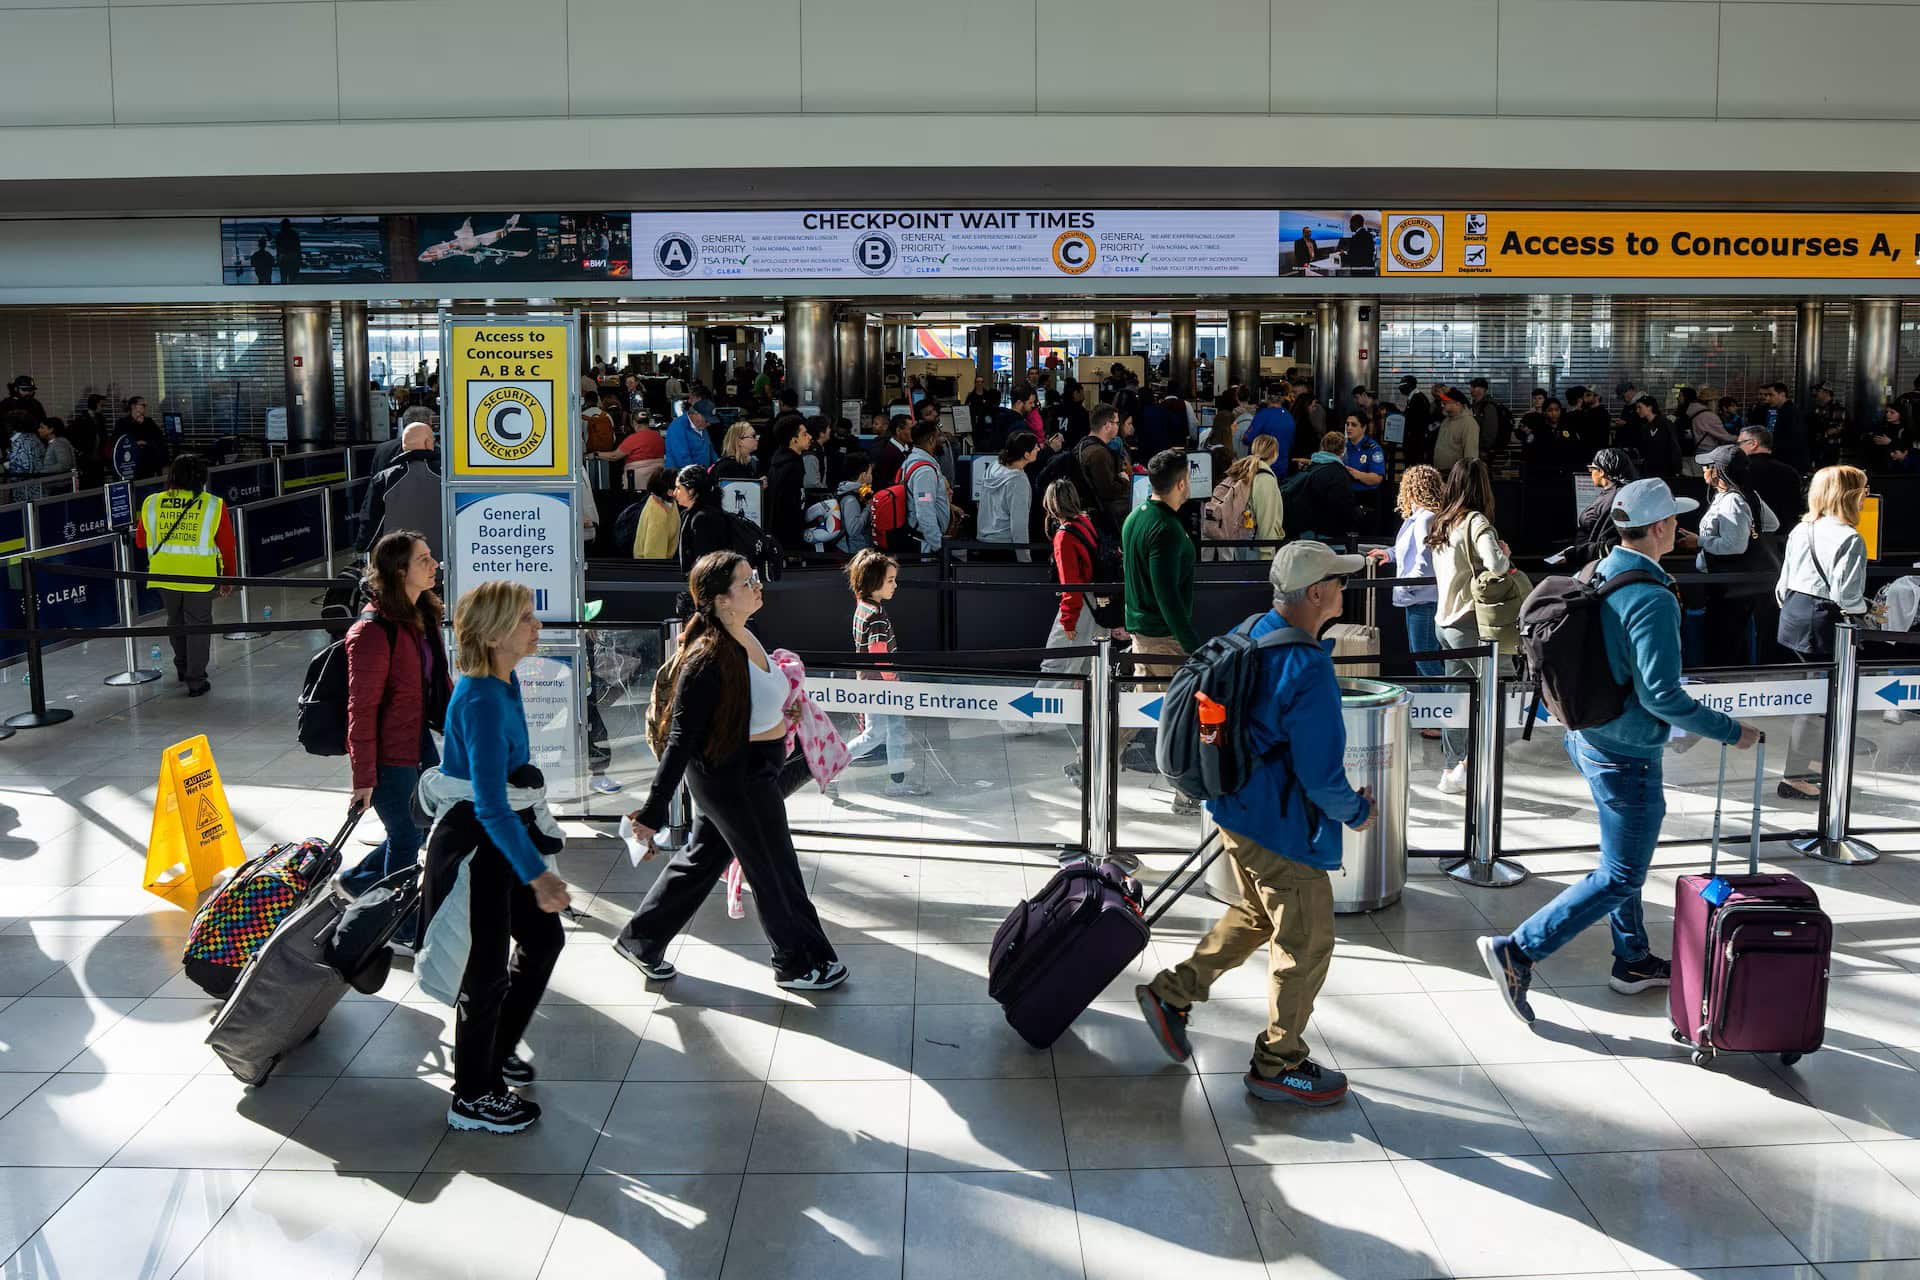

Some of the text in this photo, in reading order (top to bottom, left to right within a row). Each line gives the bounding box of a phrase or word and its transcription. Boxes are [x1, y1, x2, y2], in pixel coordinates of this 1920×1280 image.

[803, 212, 1095, 230] CHECKPOINT WAIT TIMES
[901, 234, 945, 242] GENERAL
[1100, 233, 1144, 241] GENERAL
[1403, 229, 1425, 256] C
[664, 240, 688, 266] A
[702, 245, 746, 253] PRIORITY
[865, 240, 886, 264] B
[901, 244, 945, 252] PRIORITY
[1062, 241, 1083, 264] C
[1100, 243, 1144, 252] PRIORITY
[1500, 231, 1614, 256] Access
[1626, 232, 1659, 256] to
[1671, 232, 1858, 256] Concourses
[1869, 233, 1901, 262] A,
[474, 331, 545, 342] Access to
[467, 348, 553, 360] Concourses
[480, 365, 540, 378] A, B & C
[483, 390, 537, 409] SECURITY
[494, 407, 522, 440] C
[480, 432, 542, 458] CHECKPOINT
[241, 486, 260, 496] CLEAR
[160, 512, 200, 520] AIRPORT
[483, 507, 540, 521] General
[80, 520, 104, 532] CLEAR
[160, 522, 199, 531] LANDSIDE
[479, 524, 546, 540] Boarding
[471, 543, 554, 556] Passengers
[472, 560, 552, 572] enter here.
[47, 585, 86, 604] CLEAR
[836, 688, 914, 710] Boarding
[920, 694, 998, 711] Entrance
[1700, 692, 1812, 712] ding Entrance
[1411, 706, 1453, 718] ance
[184, 770, 212, 786] CAUTION
[186, 780, 213, 796] Wet Floor
[1283, 1076, 1312, 1091] HOKA
